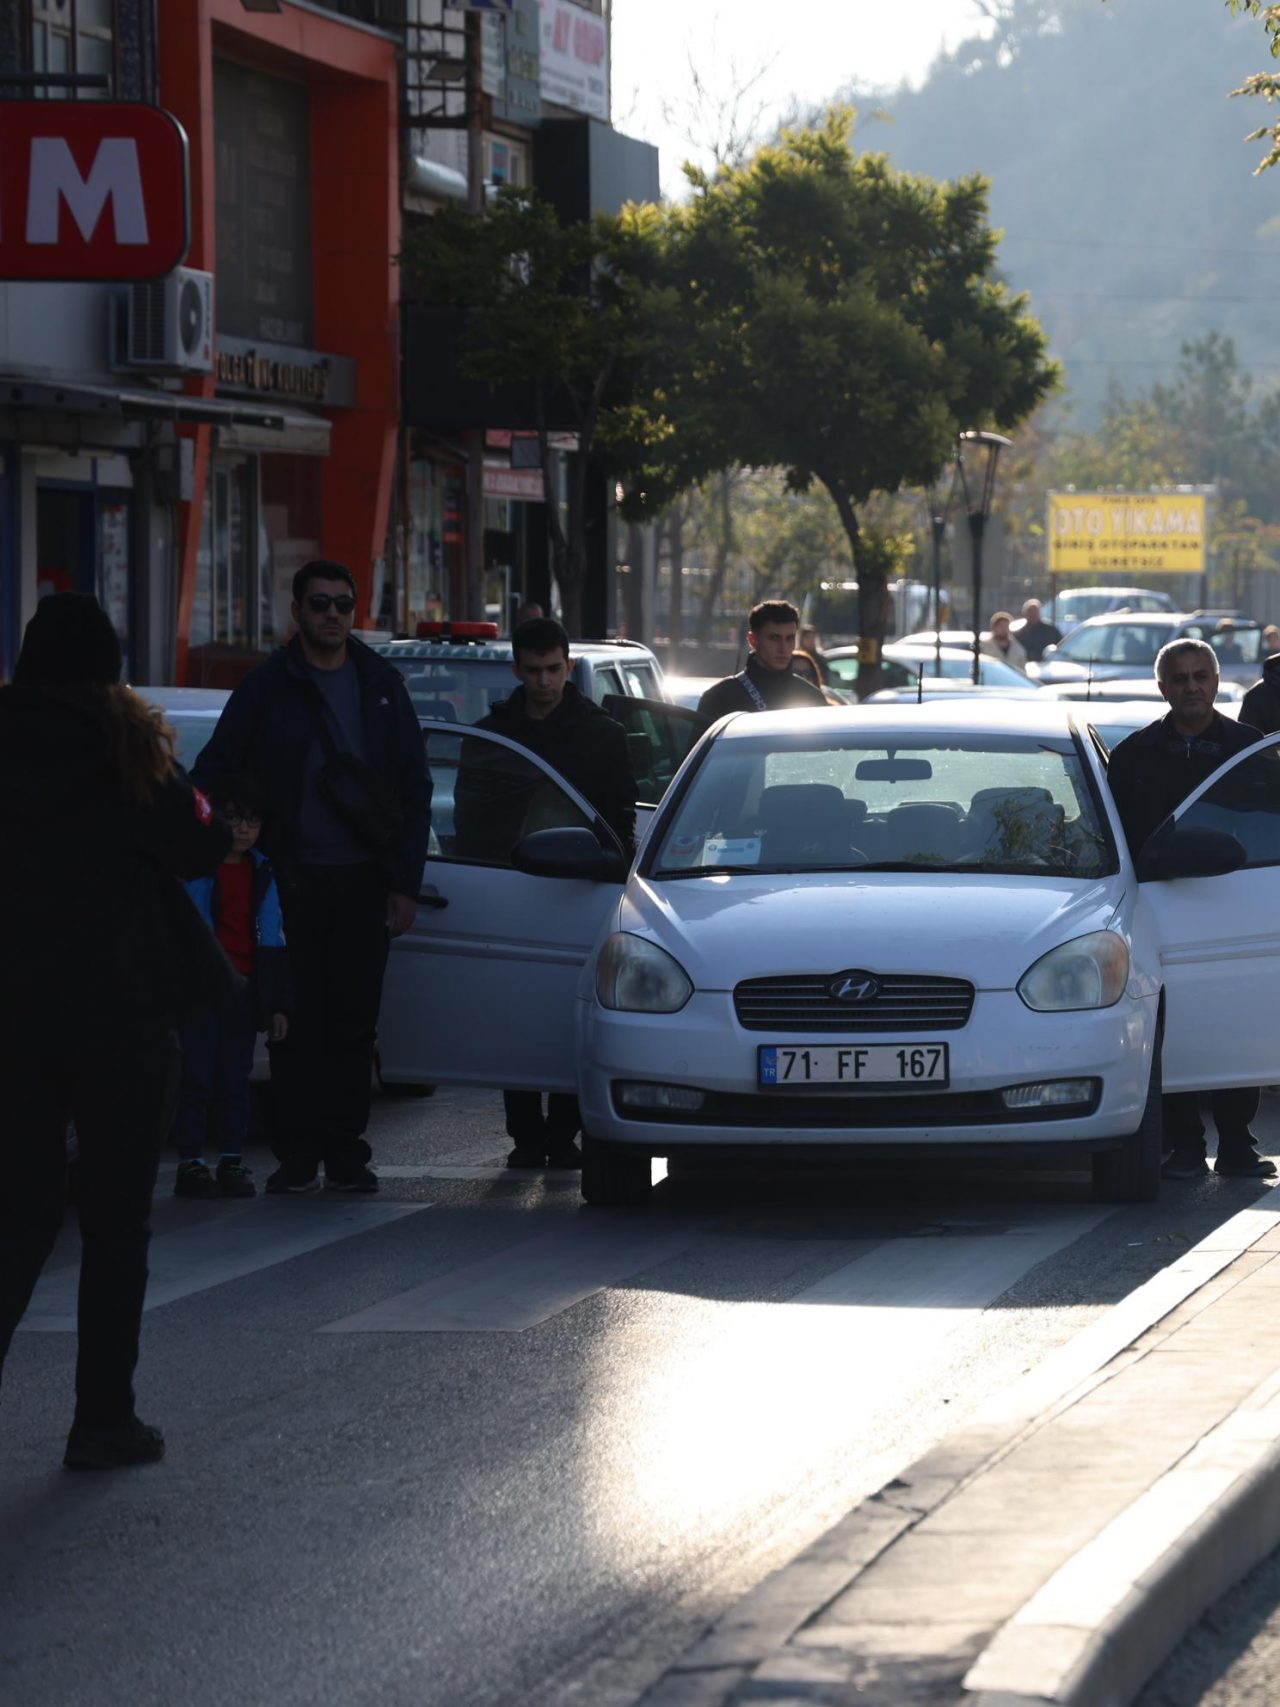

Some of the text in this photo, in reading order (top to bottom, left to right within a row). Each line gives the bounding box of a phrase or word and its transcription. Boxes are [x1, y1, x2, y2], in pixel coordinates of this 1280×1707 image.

[0, 136, 149, 245] M
[1056, 506, 1201, 536] OTO YIKAMA
[764, 1049, 942, 1080] TR 71 FF 167
